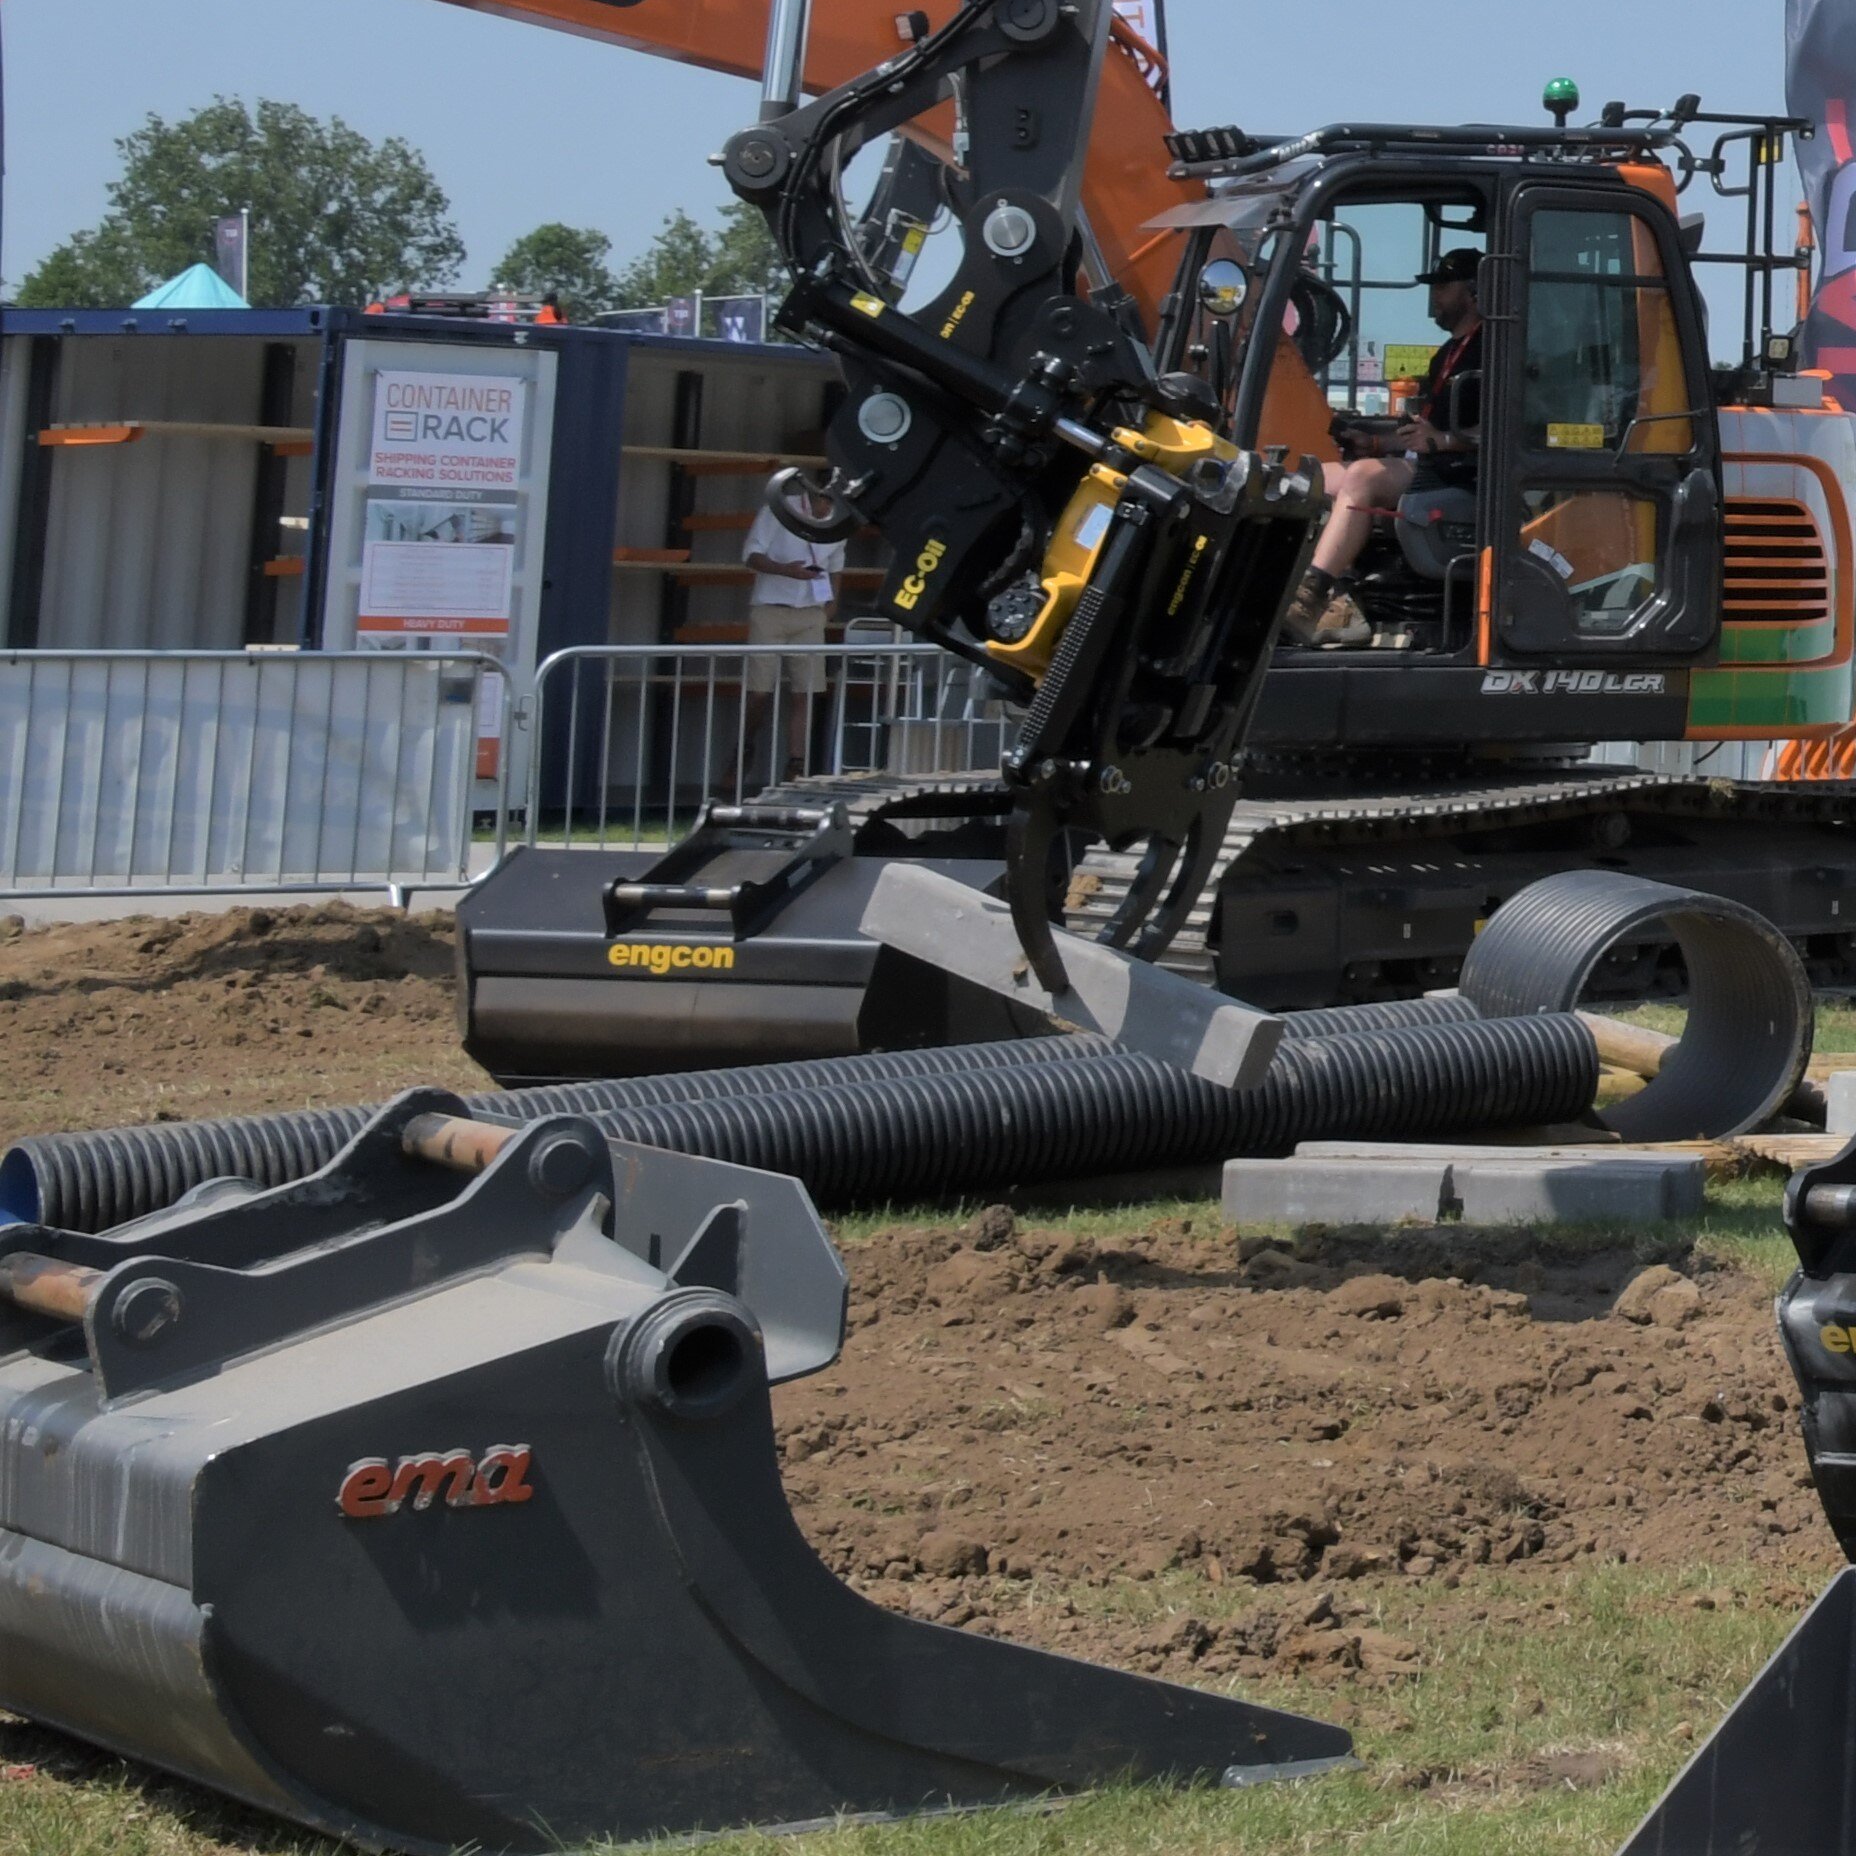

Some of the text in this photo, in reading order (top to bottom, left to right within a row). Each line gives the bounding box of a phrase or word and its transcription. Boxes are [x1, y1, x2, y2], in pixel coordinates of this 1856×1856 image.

[387, 383, 512, 414] CONTAINER
[423, 415, 509, 443] RACK
[374, 451, 516, 469] SHIPPING CONTAINER
[376, 467, 514, 483] RACKING SOLUTIONS
[399, 487, 483, 501] STANDARD DUTY
[895, 536, 948, 612] EC-Oil
[403, 618, 466, 630] HEAVY DUTY
[1480, 669, 1541, 695] DX
[608, 942, 734, 975] engcon
[337, 1445, 535, 1517] ema
